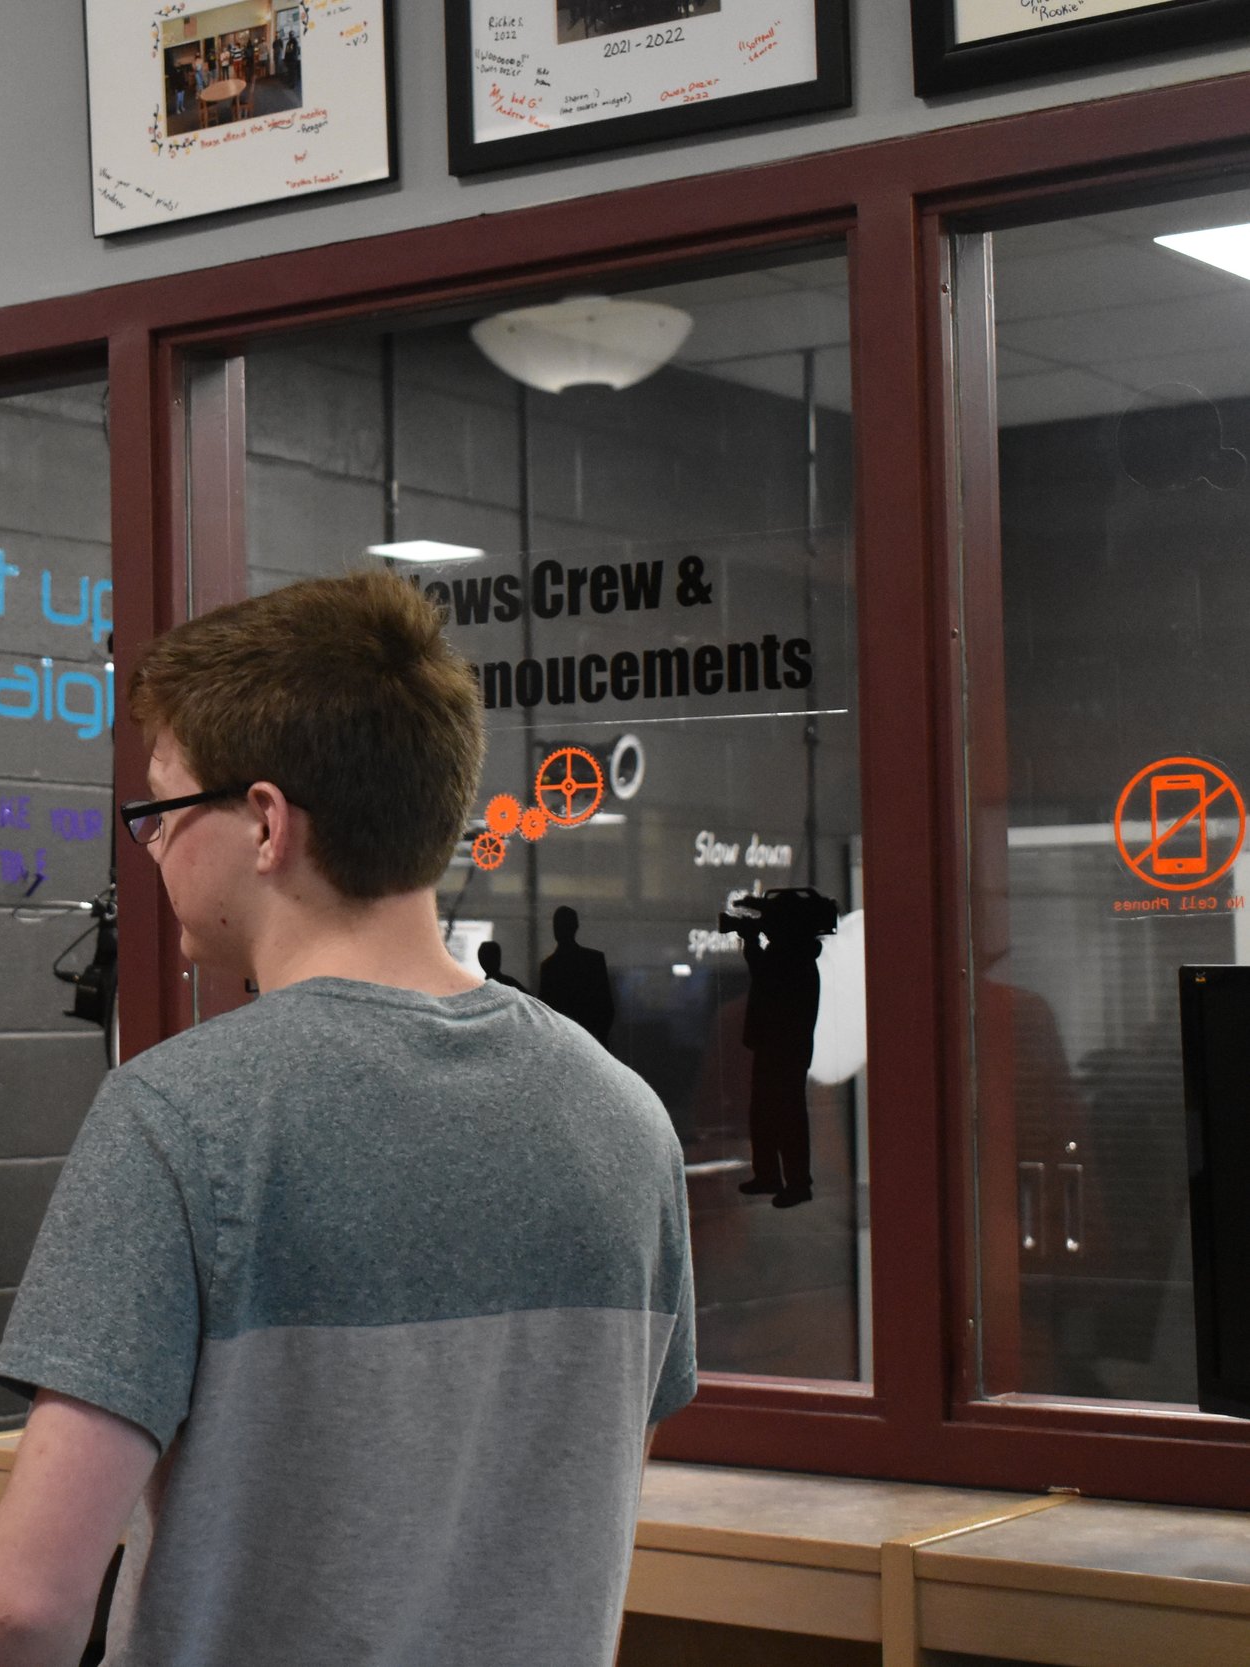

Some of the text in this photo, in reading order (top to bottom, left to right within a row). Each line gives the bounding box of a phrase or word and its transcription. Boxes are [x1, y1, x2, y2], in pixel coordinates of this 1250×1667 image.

[1031, 0, 1084, 21] "Rookie"
[603, 40, 631, 58] 2021
[646, 27, 685, 49] 2022
[410, 555, 713, 626] ews Crew &
[469, 634, 814, 709] noucements
[694, 830, 792, 868] Slow down
